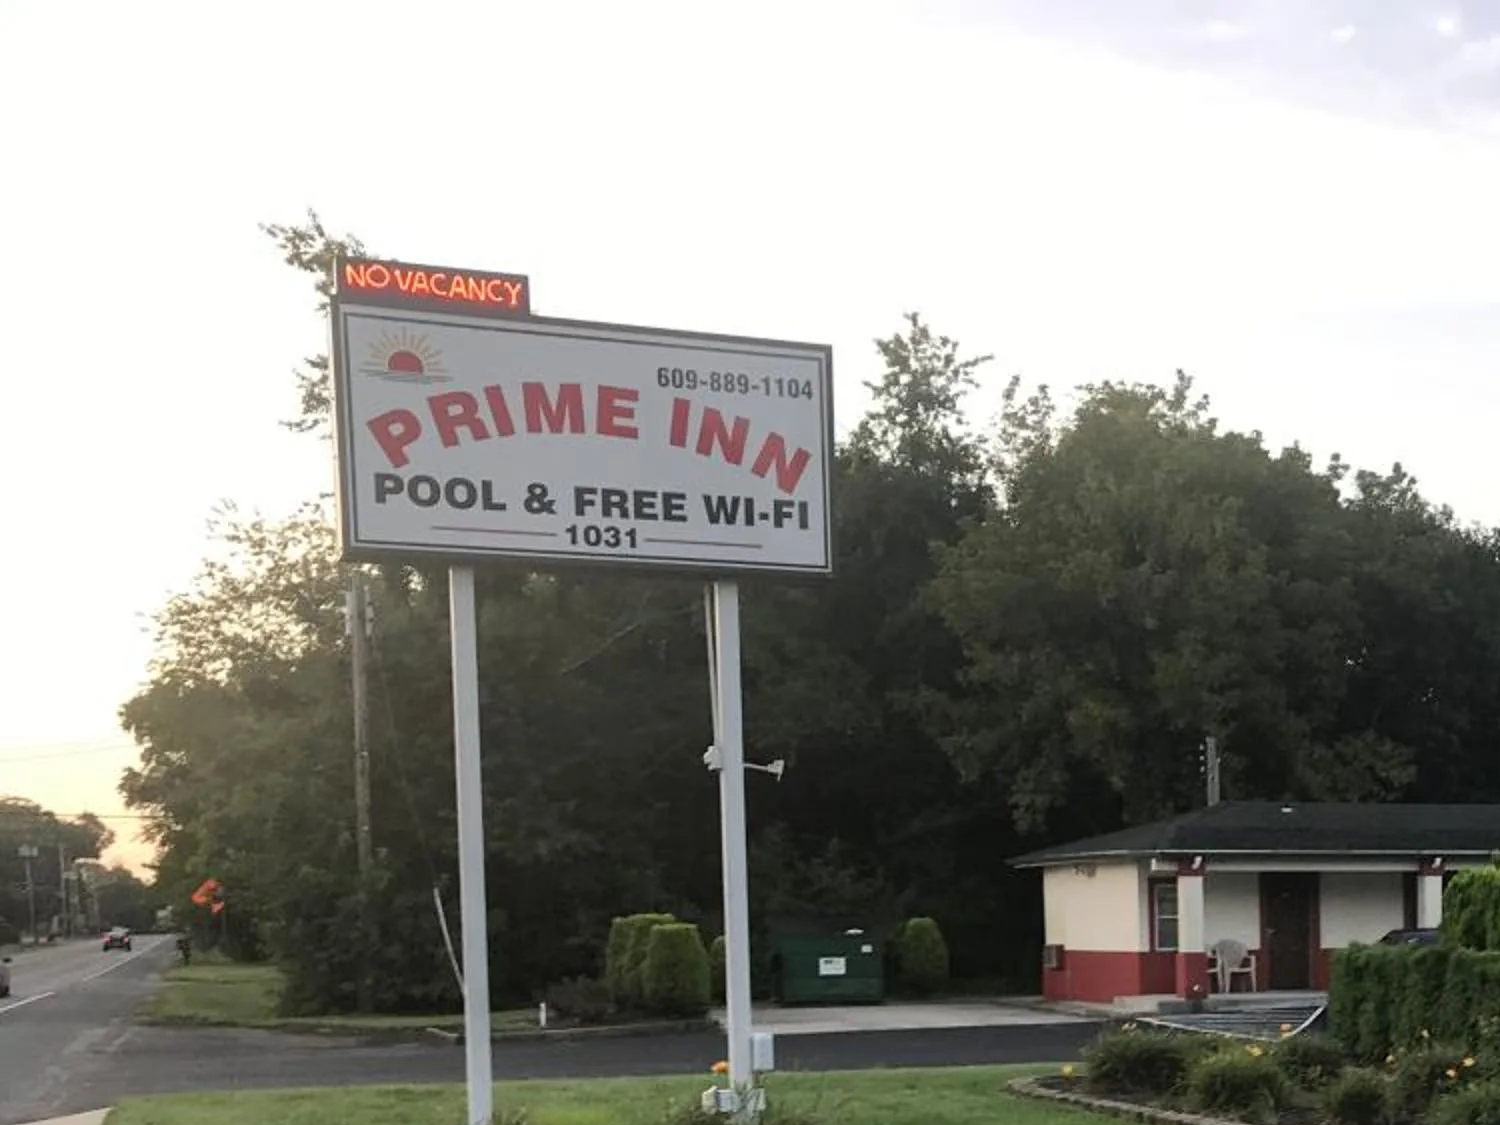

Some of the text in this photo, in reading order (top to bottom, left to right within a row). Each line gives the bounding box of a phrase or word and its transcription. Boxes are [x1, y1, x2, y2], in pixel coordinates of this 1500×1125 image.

[345, 264, 522, 306] NO VACANCY
[656, 366, 814, 400] 609-889-1104
[367, 382, 812, 495] PRIME INN
[374, 472, 809, 529] POOL & FREE WI-FI
[566, 525, 638, 549] 1031
